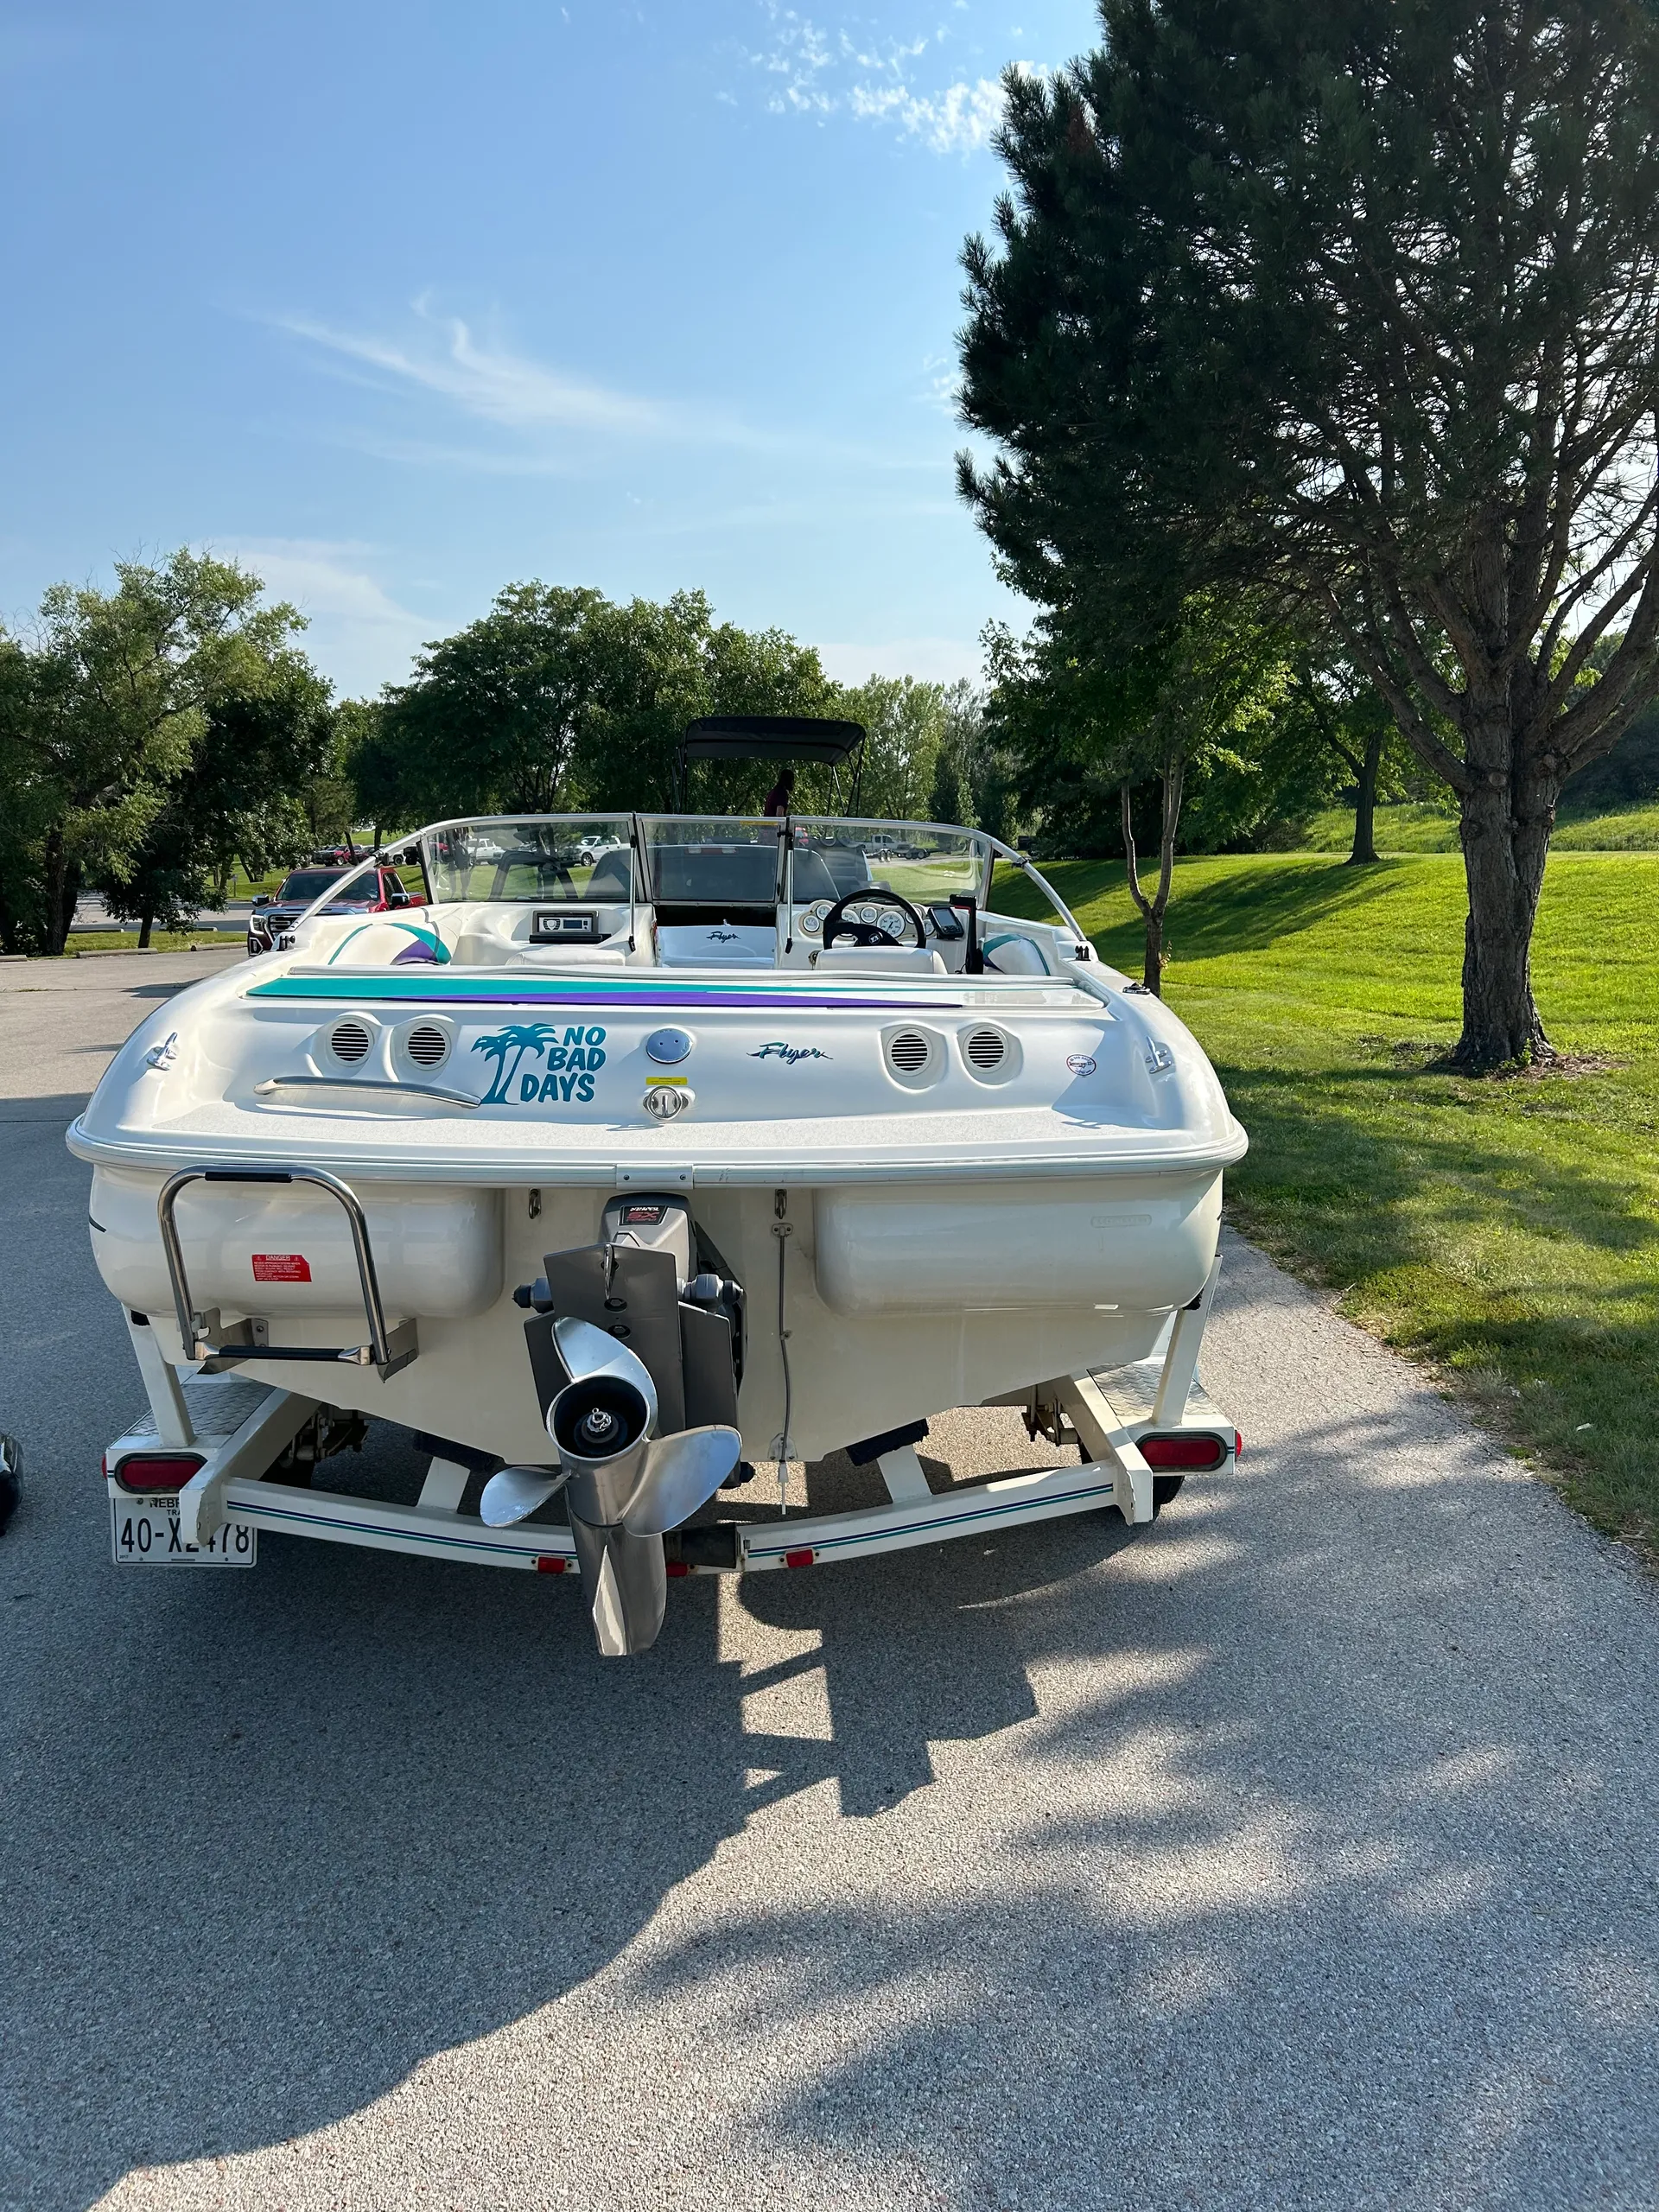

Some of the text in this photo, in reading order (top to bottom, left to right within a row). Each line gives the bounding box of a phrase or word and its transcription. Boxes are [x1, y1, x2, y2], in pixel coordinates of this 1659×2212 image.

[706, 931, 741, 944] Flyer
[563, 1026, 607, 1046] NO
[547, 1046, 607, 1072] BAD
[746, 1041, 834, 1065] Flyer
[519, 1072, 596, 1103] DAYS
